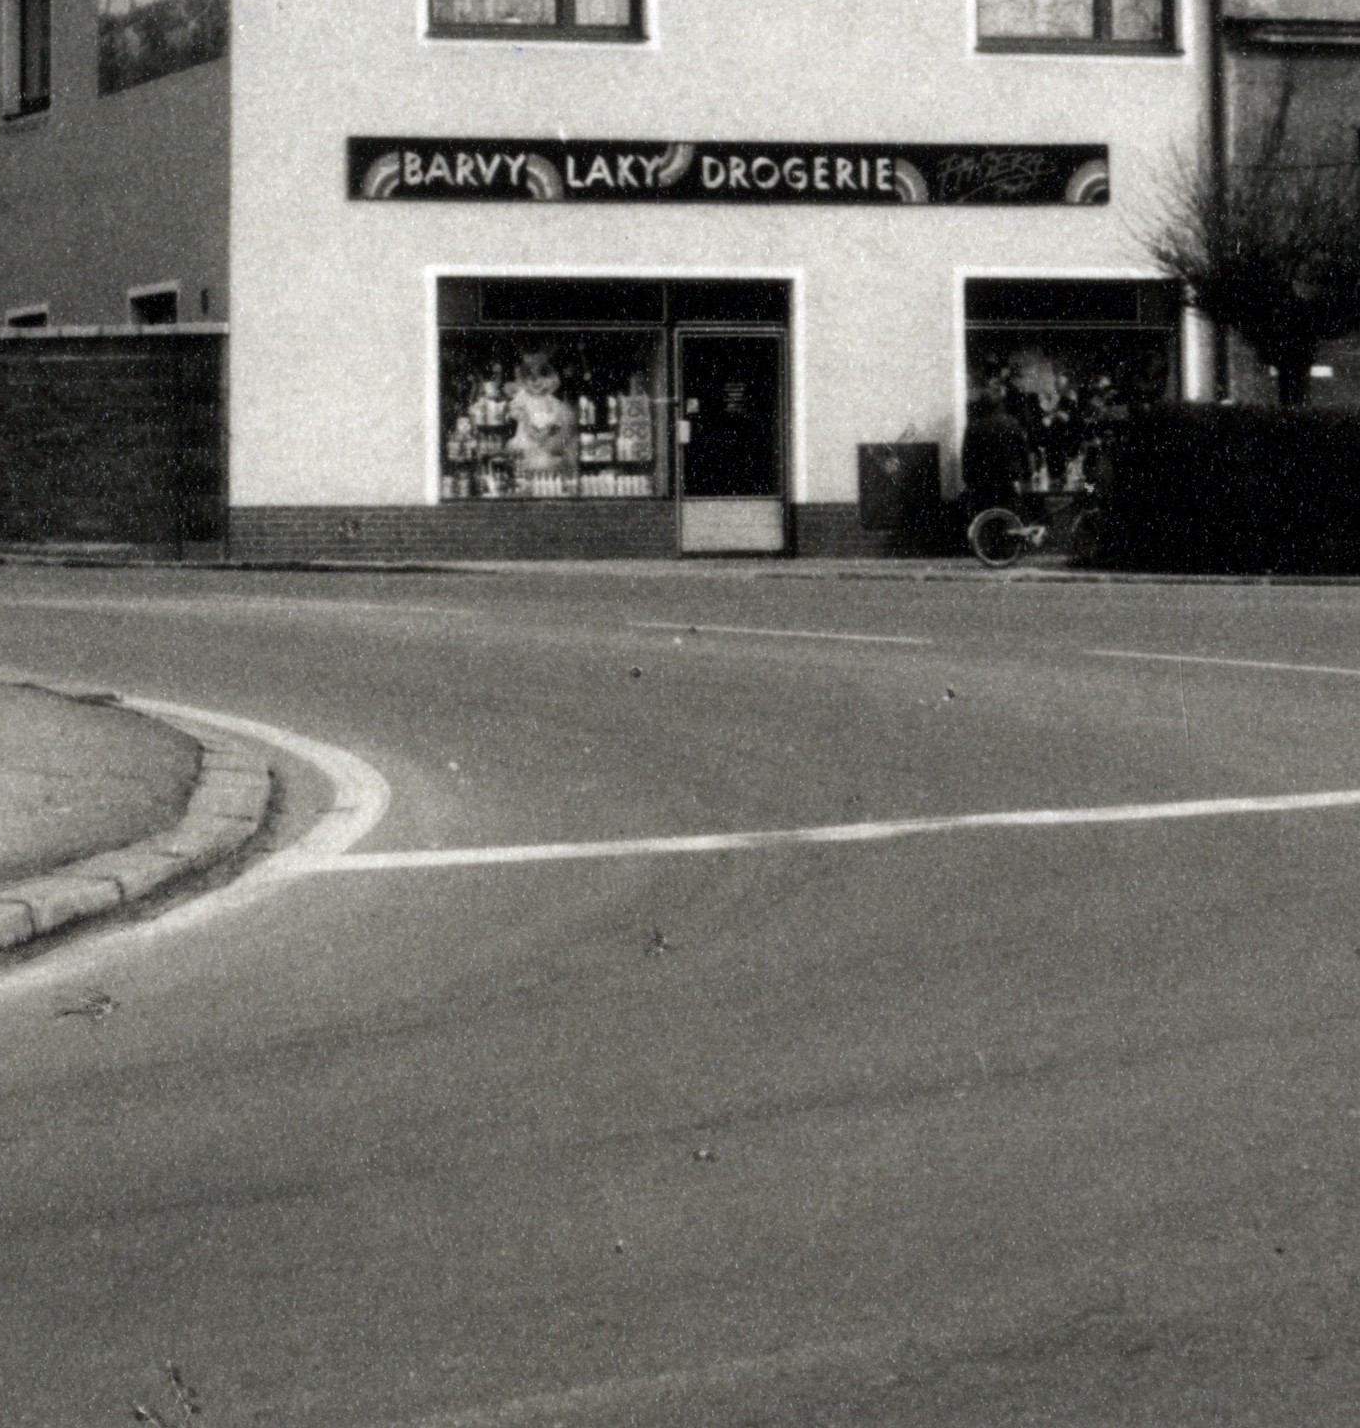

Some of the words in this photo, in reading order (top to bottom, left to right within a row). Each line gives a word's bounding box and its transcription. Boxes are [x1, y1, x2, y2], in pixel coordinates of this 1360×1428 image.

[403, 151, 526, 187] BARVY
[566, 153, 662, 189] LAKY
[701, 155, 894, 191] DROGERIE
